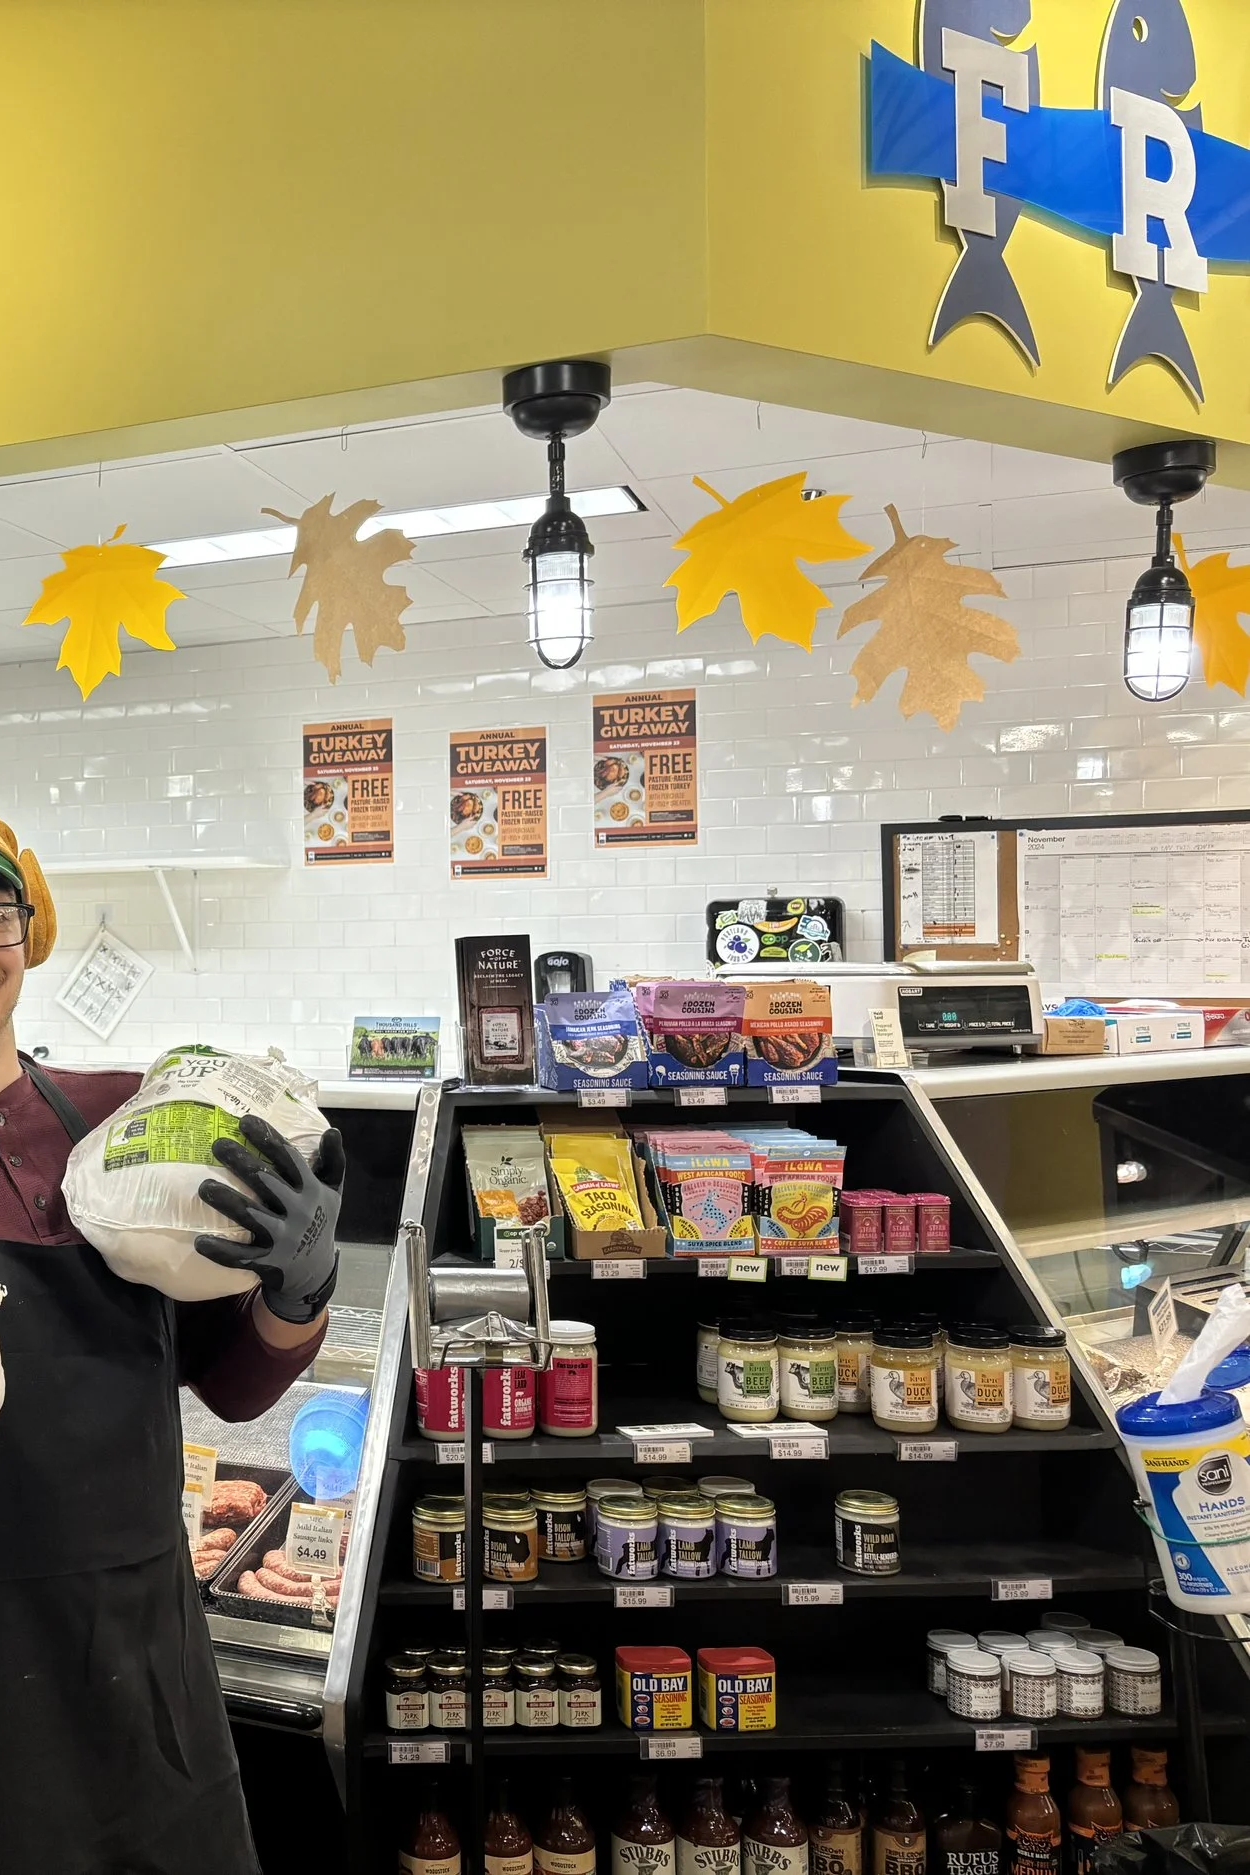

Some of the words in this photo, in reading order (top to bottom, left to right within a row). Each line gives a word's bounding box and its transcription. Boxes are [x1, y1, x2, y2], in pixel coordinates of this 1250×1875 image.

[624, 693, 663, 703] ANNUAL
[600, 704, 689, 725] TURKEY
[330, 723, 365, 732] ANNUAL
[600, 721, 690, 738] GIVEAWAY
[479, 731, 515, 740] ANNUAL
[309, 733, 387, 752] TURKEY
[309, 748, 387, 764] GIVEAWAY
[456, 742, 540, 762] TURKEY
[456, 758, 540, 774] GIVEAWAY
[649, 752, 692, 775] FREE
[351, 778, 390, 798] FREE
[648, 783, 669, 791] FROZEN
[670, 782, 690, 790] TURKEY
[501, 789, 543, 810] FREE
[501, 818, 521, 826] FROZEN
[522, 817, 541, 825] TURKEY
[480, 948, 516, 959] FORCE
[478, 960, 519, 970] NATURE
[597, 1024, 621, 1032] SEASONING
[668, 1071, 707, 1081] SEASONING
[708, 1070, 728, 1080] SAUCE
[763, 1072, 801, 1081] SEASONING
[802, 1071, 823, 1080] SAUCE
[573, 1079, 610, 1088] SEASONING
[611, 1078, 632, 1087] SAUCE
[490, 1166, 524, 1179] Simply
[676, 1172, 697, 1181] WEST
[698, 1171, 724, 1179] AFRICAN
[724, 1171, 746, 1181] FOODS
[489, 1175, 528, 1188] Organic
[816, 1174, 838, 1184] FOODS
[573, 1183, 595, 1192] GARDEN
[585, 1191, 617, 1202] TACO
[736, 1263, 760, 1273] new
[815, 1262, 840, 1272] new
[864, 1265, 888, 1273] $12.99
[514, 1371, 526, 1380] LEAF
[745, 1375, 770, 1385] BEEF
[812, 1375, 835, 1385] BEEF
[906, 1387, 931, 1396] DUCK
[977, 1388, 1004, 1398] DUCK
[1052, 1385, 1070, 1395] DUCK
[448, 1366, 459, 1429] fatworks
[643, 1453, 668, 1462] $14.99
[908, 1452, 933, 1460] $14.99
[1144, 1459, 1190, 1468] SANI-HANDS
[1198, 1464, 1230, 1482] sani
[1198, 1496, 1246, 1513] HANDS
[1186, 1513, 1213, 1521] INSTANT
[1213, 1507, 1246, 1519] SANITIZING
[312, 1524, 333, 1534] Italian
[554, 1523, 571, 1532] BISON
[293, 1533, 318, 1543] Sausage
[318, 1534, 333, 1544] links
[554, 1532, 576, 1541] TALLOW
[863, 1534, 880, 1543] WILD
[490, 1542, 507, 1551] BISON
[678, 1542, 695, 1551] LAMB
[738, 1540, 756, 1550] LAMB
[854, 1524, 862, 1568] fatworks
[863, 1543, 874, 1552] FAT
[297, 1546, 327, 1560] $4.49
[669, 1528, 677, 1573] fatworks
[738, 1550, 762, 1560] TALLOW
[490, 1553, 513, 1562] TALLOW
[678, 1551, 701, 1561] TALLOW
[795, 1595, 820, 1603] $15.99
[1004, 1590, 1029, 1598] $15.99
[622, 1597, 647, 1605] $15.99
[632, 1677, 657, 1692] OLD
[661, 1676, 685, 1691] BAY
[717, 1679, 743, 1693] OLD
[746, 1678, 770, 1692] BAY
[654, 1692, 687, 1704] SEASONING
[739, 1693, 772, 1705] SEASONING
[983, 1740, 1005, 1749] $7.99
[655, 1749, 677, 1758] $6.99
[619, 1845, 671, 1868] STUBB'S
[947, 1851, 999, 1866] RUFUS
[502, 1864, 526, 1872] WOODSTOCK
[550, 1861, 577, 1869] WOODSTOCK
[948, 1864, 998, 1875] TEAGUE
[425, 1867, 450, 1875] WOODSTOCK
